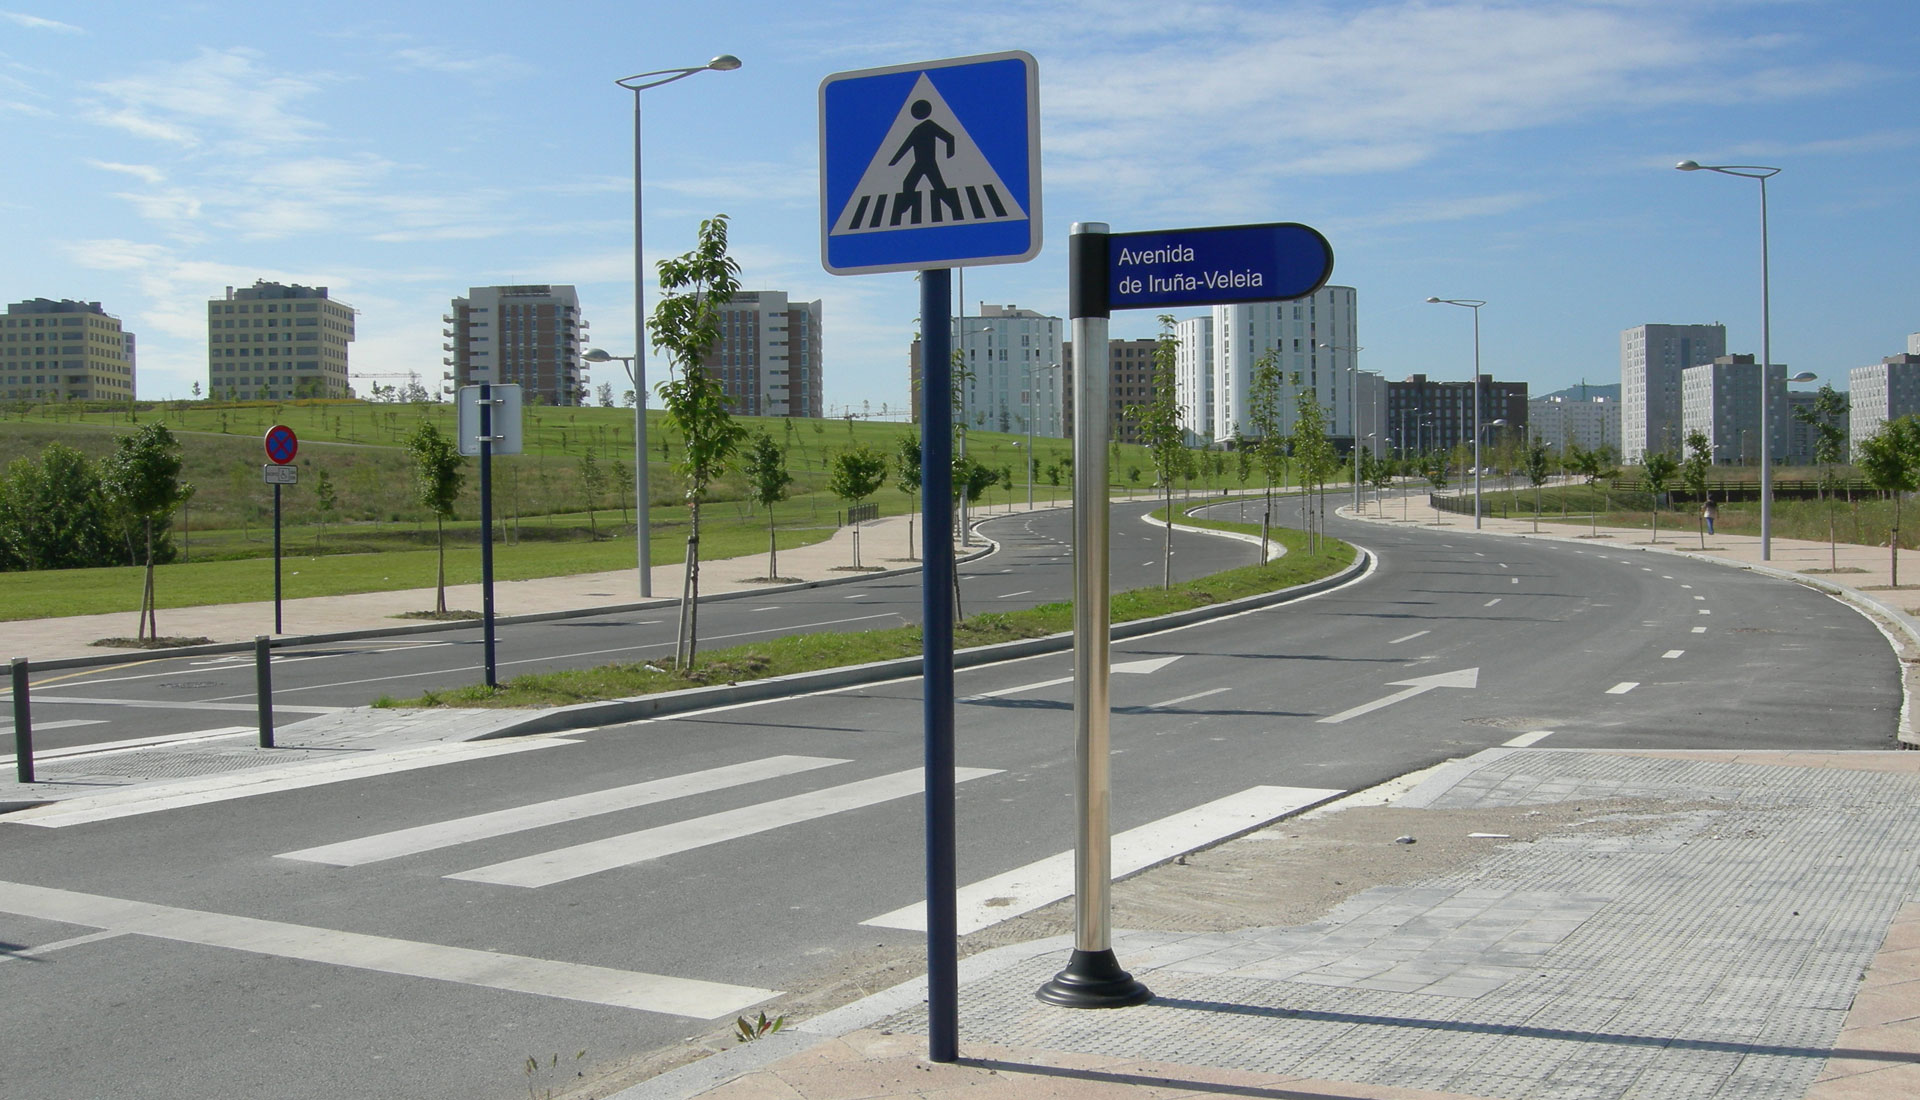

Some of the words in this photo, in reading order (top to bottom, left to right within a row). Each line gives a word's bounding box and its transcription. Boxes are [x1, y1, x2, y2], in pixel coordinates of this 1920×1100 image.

[1118, 244, 1195, 266] Avenida
[1119, 276, 1142, 294] de
[1149, 269, 1263, 293] Iruña-Veleia
